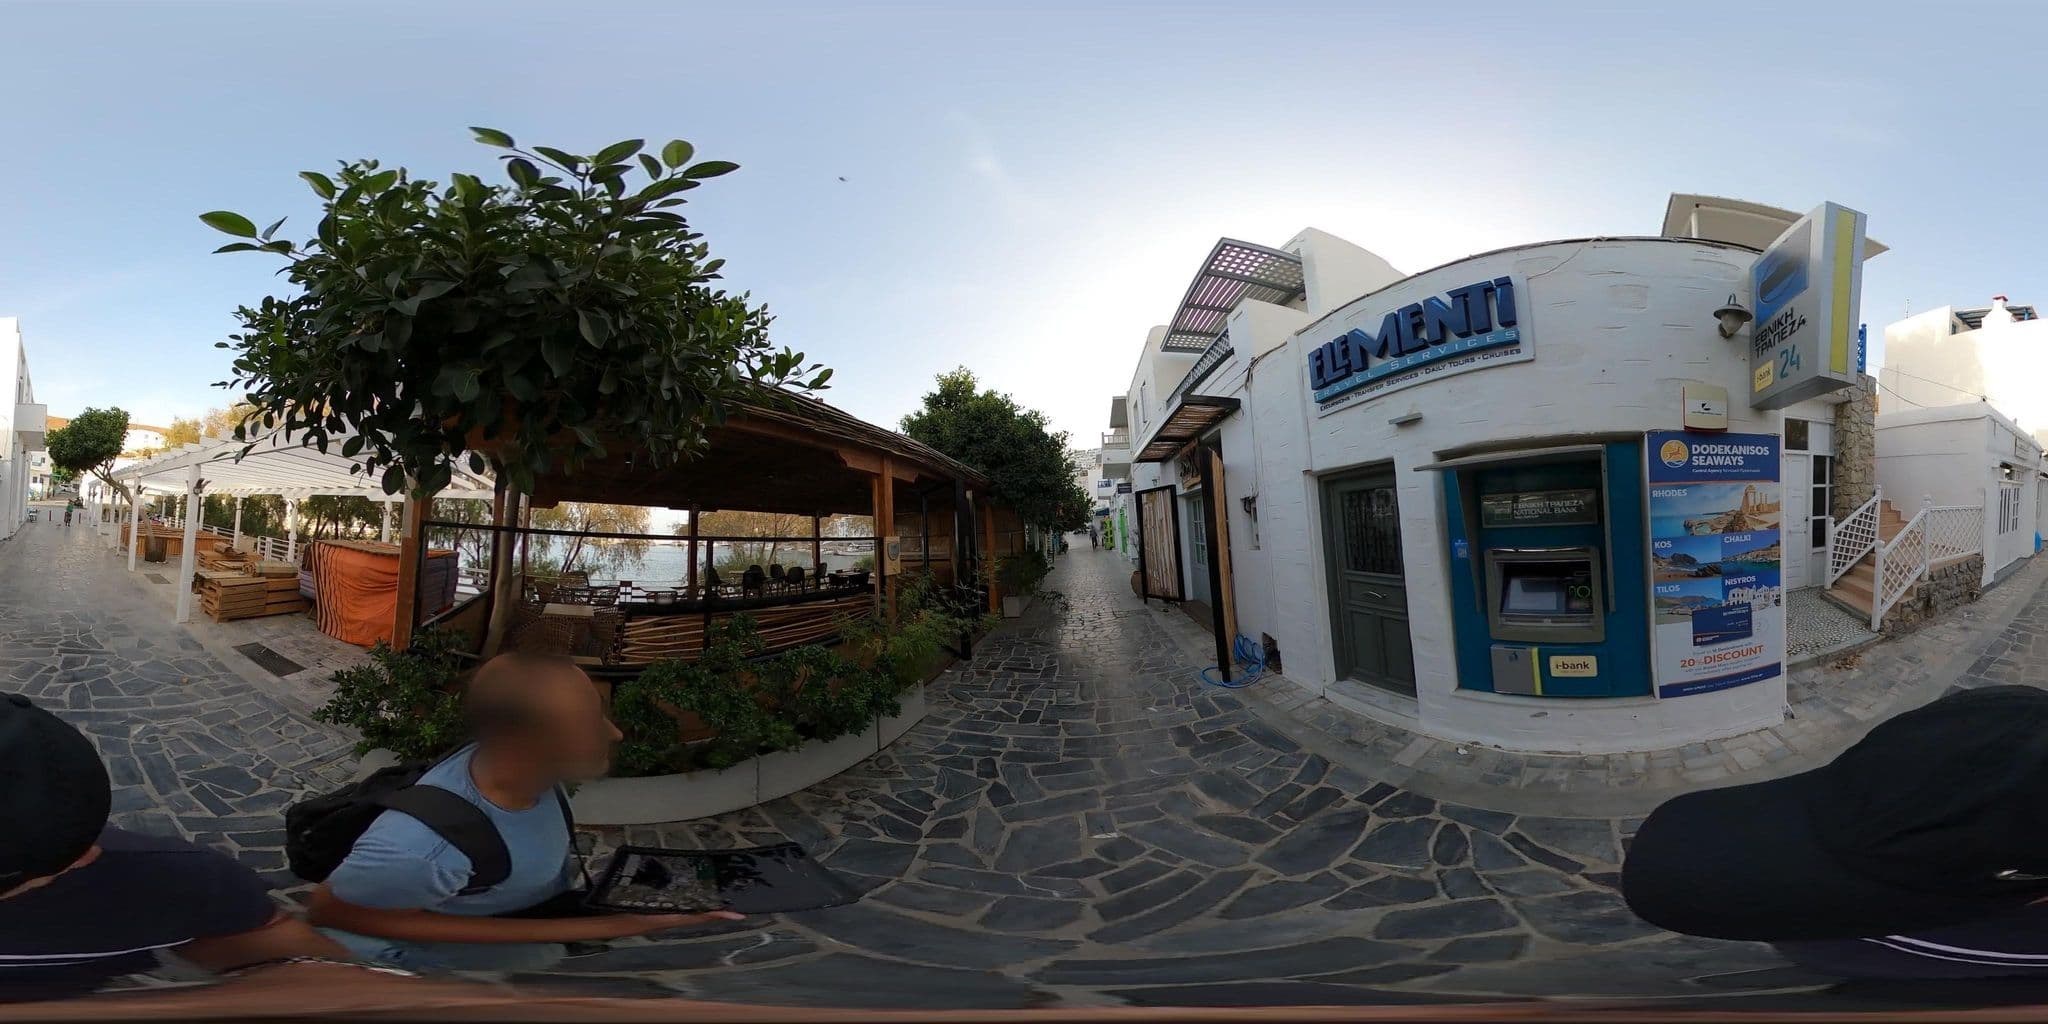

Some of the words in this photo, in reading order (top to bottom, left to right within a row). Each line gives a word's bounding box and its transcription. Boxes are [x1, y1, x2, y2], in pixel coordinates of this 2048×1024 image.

[1755, 307, 1794, 347] ΕΘΝΙΚΗ
[1755, 314, 1806, 358] ΤΡΑΠΕΖΑ
[1314, 371, 1374, 401] TRAVEL
[1391, 330, 1517, 369] SERVICES
[1780, 344, 1800, 379] 24
[1692, 445, 1769, 455] DODEKANISOS
[1692, 456, 1744, 466] SEAWAYS
[1652, 489, 1688, 498] RHODES
[1514, 507, 1552, 516] NATIONAL
[1654, 541, 1672, 549] KOS
[1656, 584, 1680, 593] TILOS
[1704, 645, 1764, 664] DISCOUNT
[1556, 661, 1590, 670] i-bank
